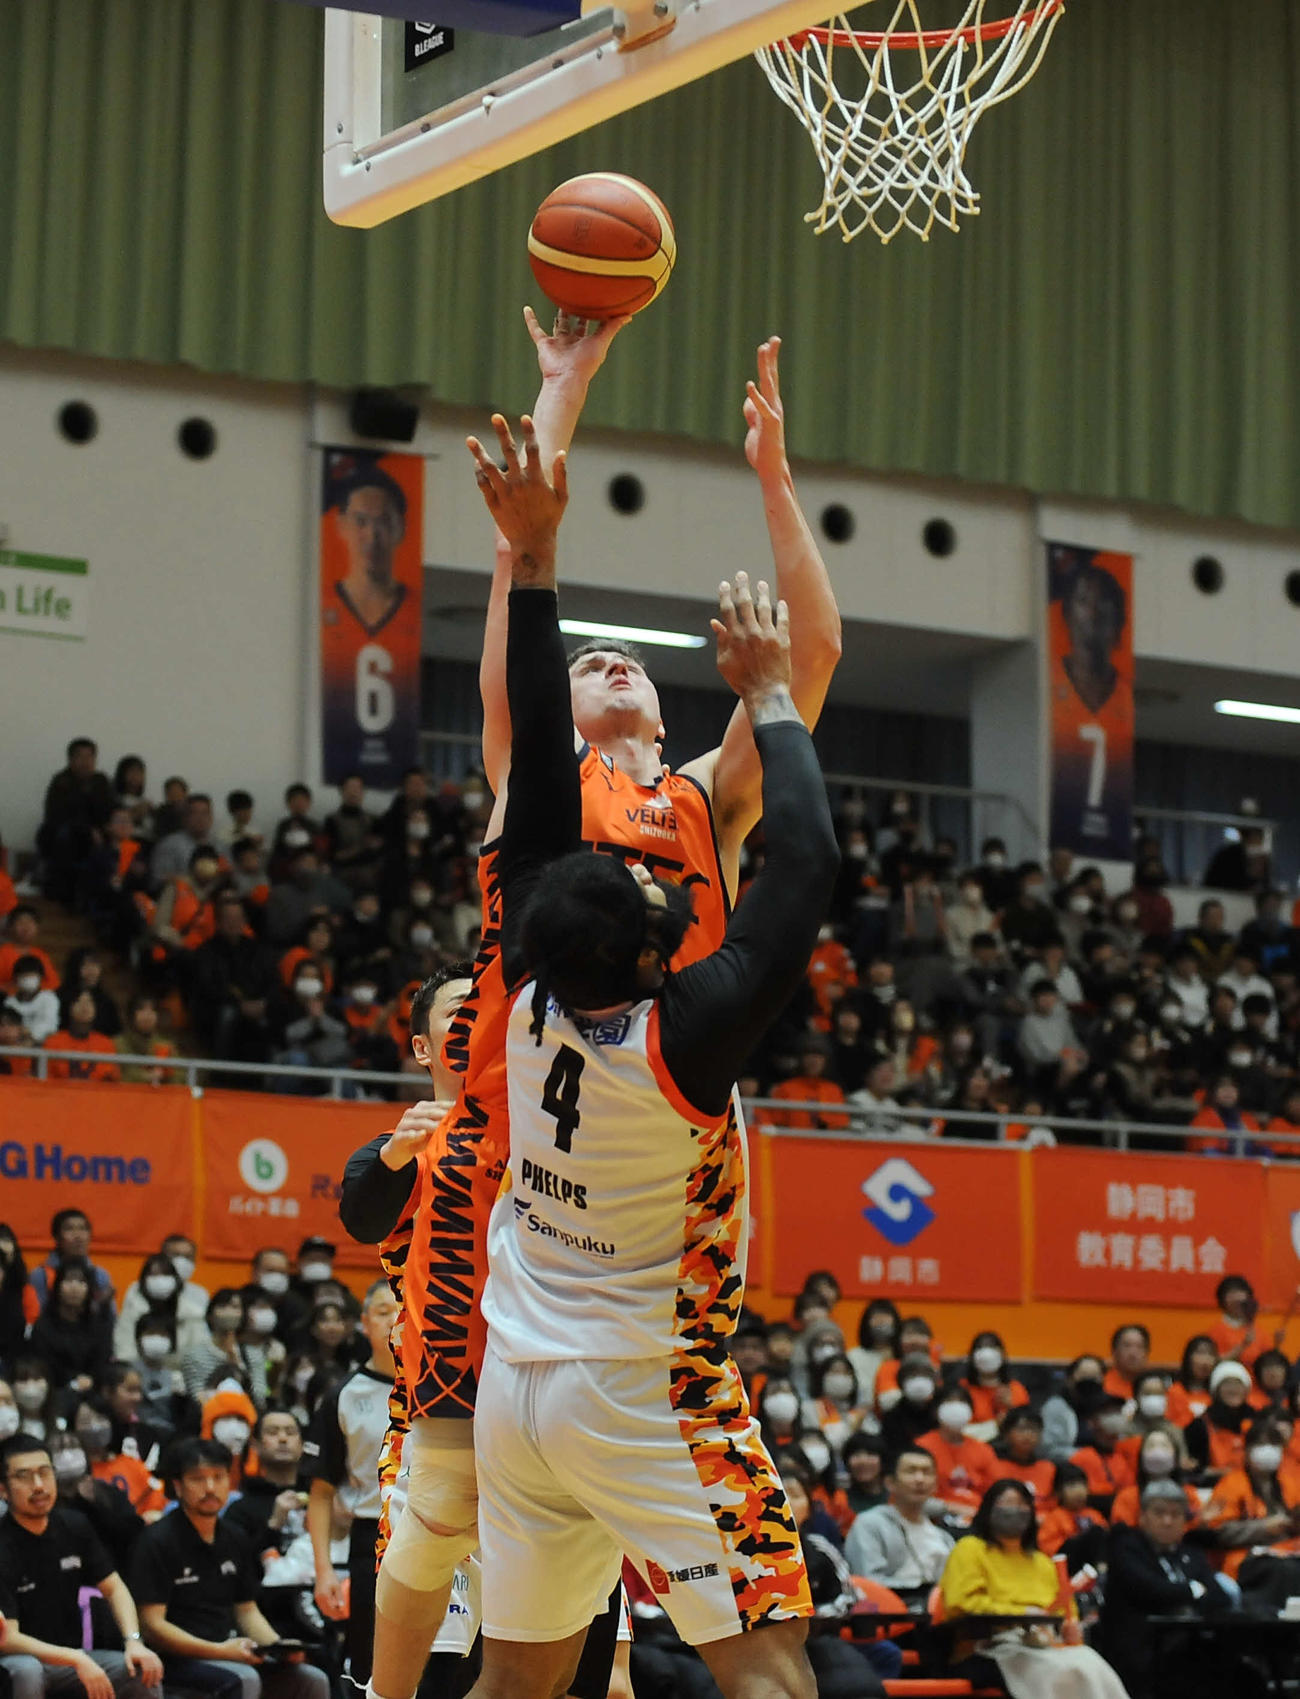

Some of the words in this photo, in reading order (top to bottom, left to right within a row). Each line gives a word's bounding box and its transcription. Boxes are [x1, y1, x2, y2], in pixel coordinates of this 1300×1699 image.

[16, 583, 72, 621] Life
[357, 643, 394, 733] 6
[1079, 724, 1106, 808] 7
[541, 1043, 585, 1154] 4
[522, 1158, 587, 1210] PHELPS
[527, 1213, 615, 1256] Sanpuku
[1076, 1230, 1228, 1274] 教育委員会
